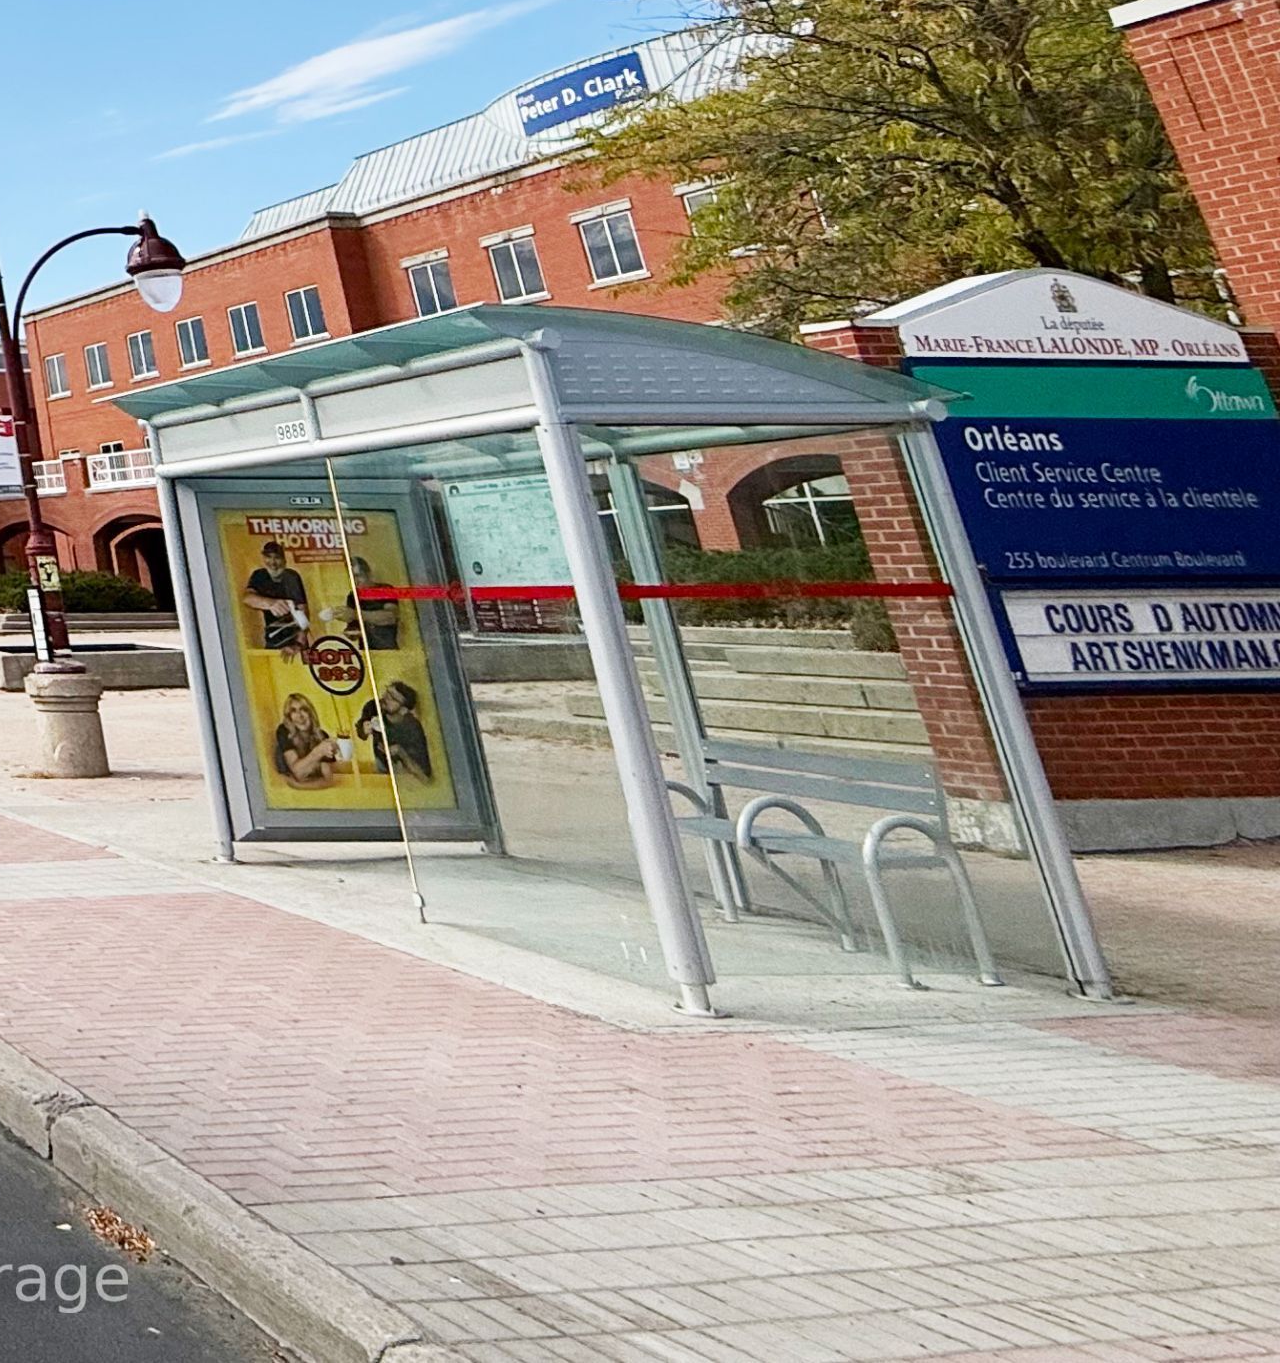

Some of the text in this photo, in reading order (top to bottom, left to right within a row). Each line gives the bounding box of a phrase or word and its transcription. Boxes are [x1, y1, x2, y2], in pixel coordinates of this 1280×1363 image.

[519, 68, 640, 123] Peter D. Clark
[1040, 315, 1057, 330] La
[913, 334, 1037, 354] MARIE-FRANCE
[1037, 336, 1132, 357] LALONDE,
[1130, 338, 1159, 356] MP
[1171, 339, 1241, 358] ORLÉANS
[277, 422, 306, 441] 9888
[964, 425, 1064, 452] Orléans
[975, 461, 1163, 483] Client Service Centre
[984, 488, 1046, 509] Centre
[1049, 486, 1075, 509] du
[1078, 487, 1141, 509] service
[1143, 487, 1158, 508] à
[1157, 486, 1180, 508] la
[249, 518, 283, 534] THE
[275, 534, 311, 549] HOT
[1004, 550, 1246, 569] 255 boulevard Centrum Boulevard
[1044, 603, 1135, 633] COURS
[1151, 603, 1173, 633] D
[300, 648, 354, 666] HOT
